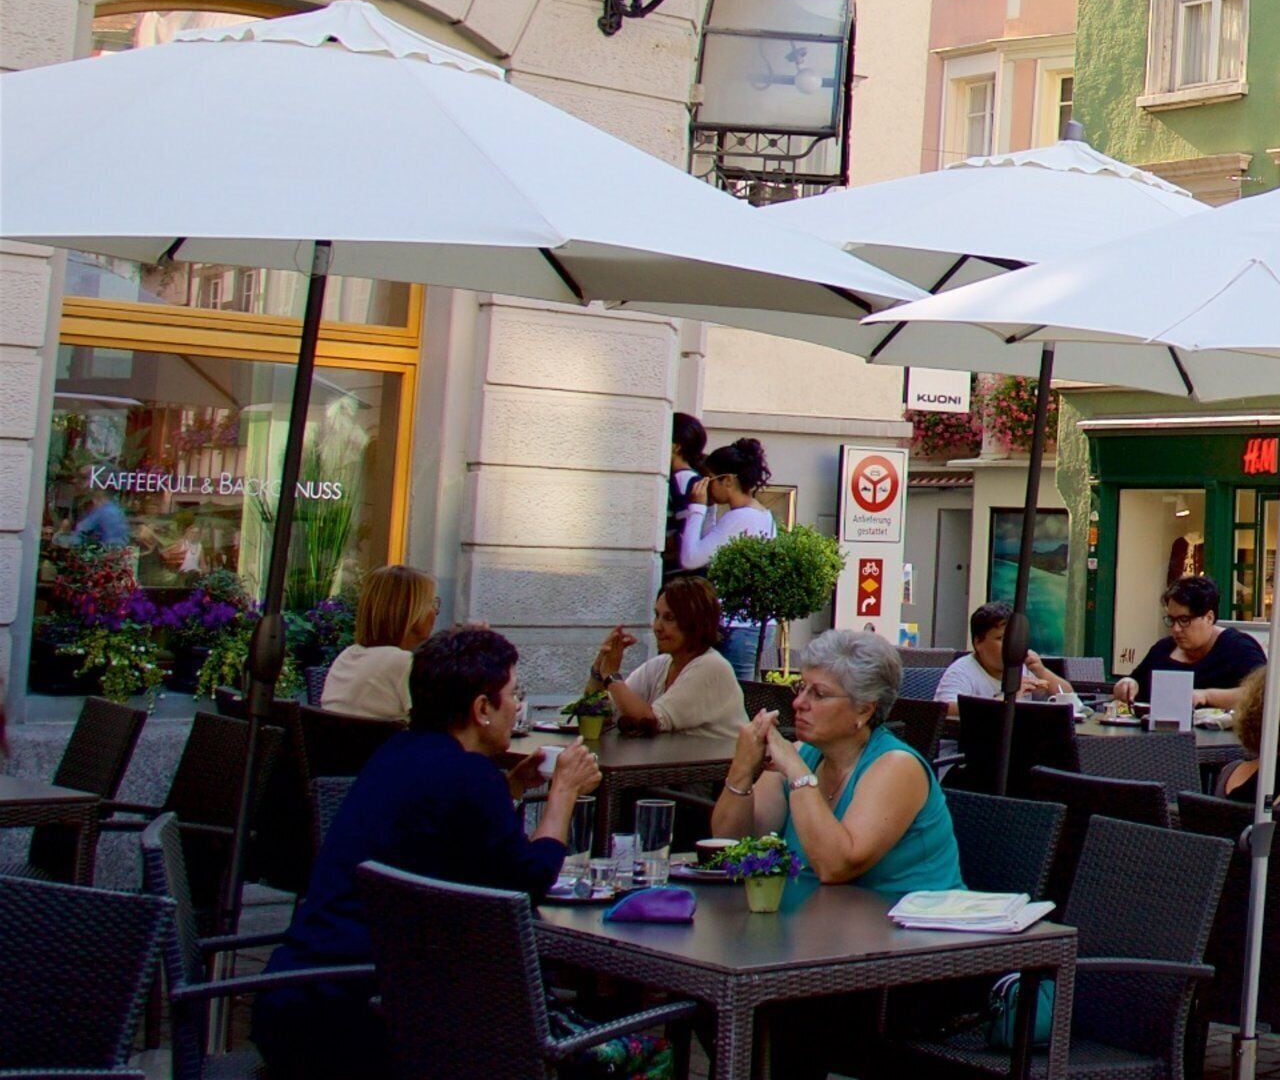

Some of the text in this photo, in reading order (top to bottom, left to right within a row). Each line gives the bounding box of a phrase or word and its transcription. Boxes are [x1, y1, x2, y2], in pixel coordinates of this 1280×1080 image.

[916, 393, 961, 404] KUONI
[89, 465, 343, 500] KAFFEEKULT & BACKGNUSS
